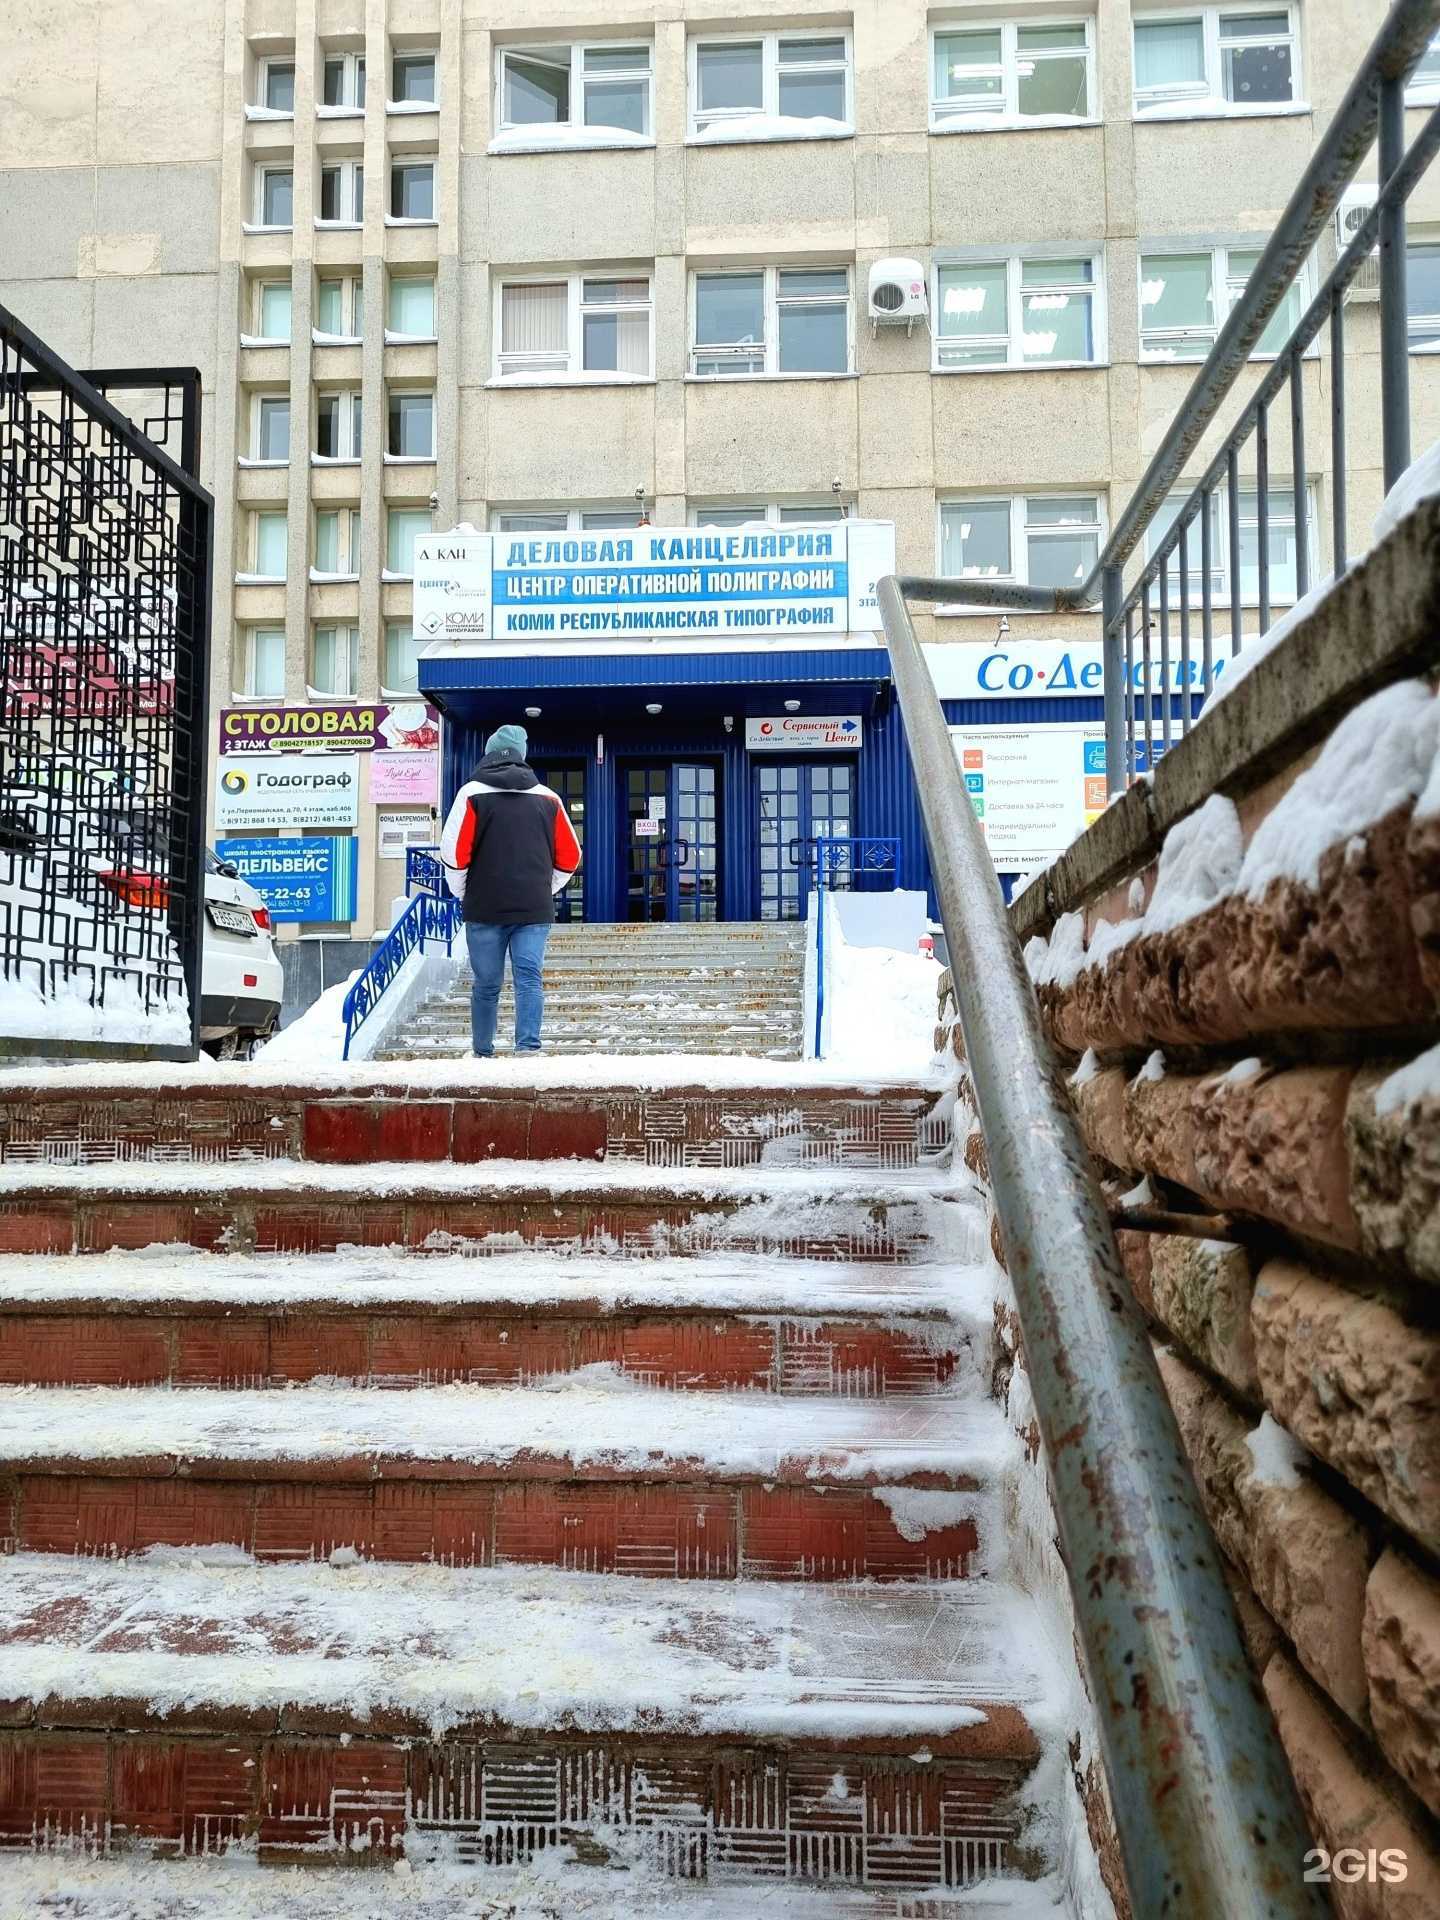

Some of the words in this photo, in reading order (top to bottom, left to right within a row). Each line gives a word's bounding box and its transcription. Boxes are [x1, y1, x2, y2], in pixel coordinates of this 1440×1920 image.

[506, 539, 633, 566] ДЕЛОВАЯ
[650, 534, 832, 562] КАНЦЕЛЯРИЯ
[506, 575, 566, 599] ЦЕНТР
[572, 568, 702, 596] ОПЕРАТИВНОЙ
[707, 569, 834, 593] ПОЛИГРАФИИ
[868, 582, 876, 593] 2
[445, 612, 484, 625] КОМИ
[506, 613, 555, 631] КОМИ
[560, 610, 719, 630] РЕСПУБЛИКАНСКАЯ
[724, 606, 834, 627] ТИПОГРАФИЯ
[224, 711, 375, 735] СТОЛОВАЯ
[783, 719, 839, 732] Сервисный
[225, 740, 232, 749] 2
[234, 739, 266, 749] ЭТАЖ
[824, 731, 858, 744] Центр
[256, 771, 352, 788] Годограф
[250, 849, 301, 857] иностранных
[255, 887, 311, 899] 5-22-63
